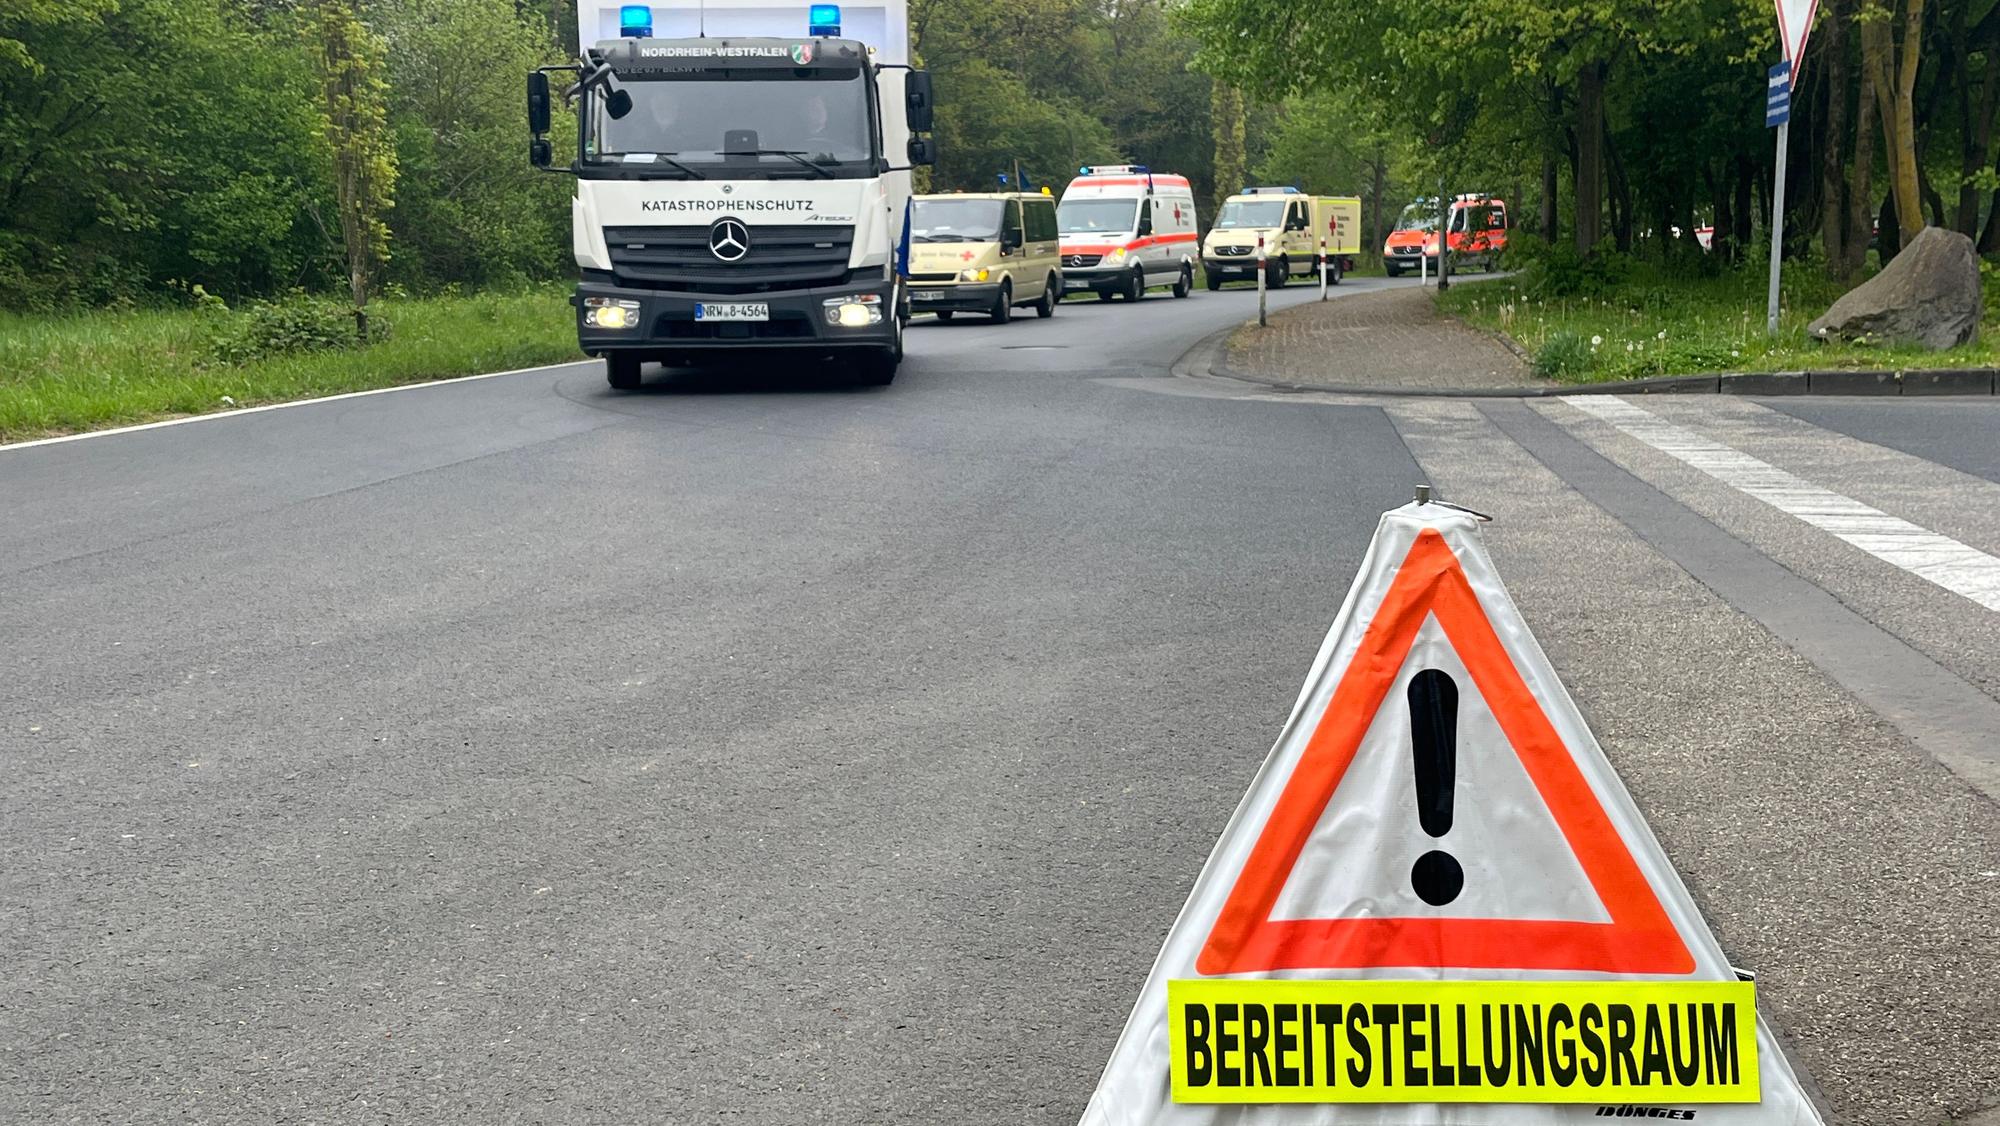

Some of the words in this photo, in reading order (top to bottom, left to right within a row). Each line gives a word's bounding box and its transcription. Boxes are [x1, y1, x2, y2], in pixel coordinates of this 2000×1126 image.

[641, 47, 788, 58] NORDRHEIN-WESTFALEN
[642, 200, 814, 211] KATASTROPHENSCHUTZ
[703, 305, 723, 317] NRW
[729, 305, 767, 317] 8-4564
[1184, 1002, 1741, 1089] BEREITSTELLUNGSRAUM
[1595, 1104, 1697, 1121] DÖNGES
